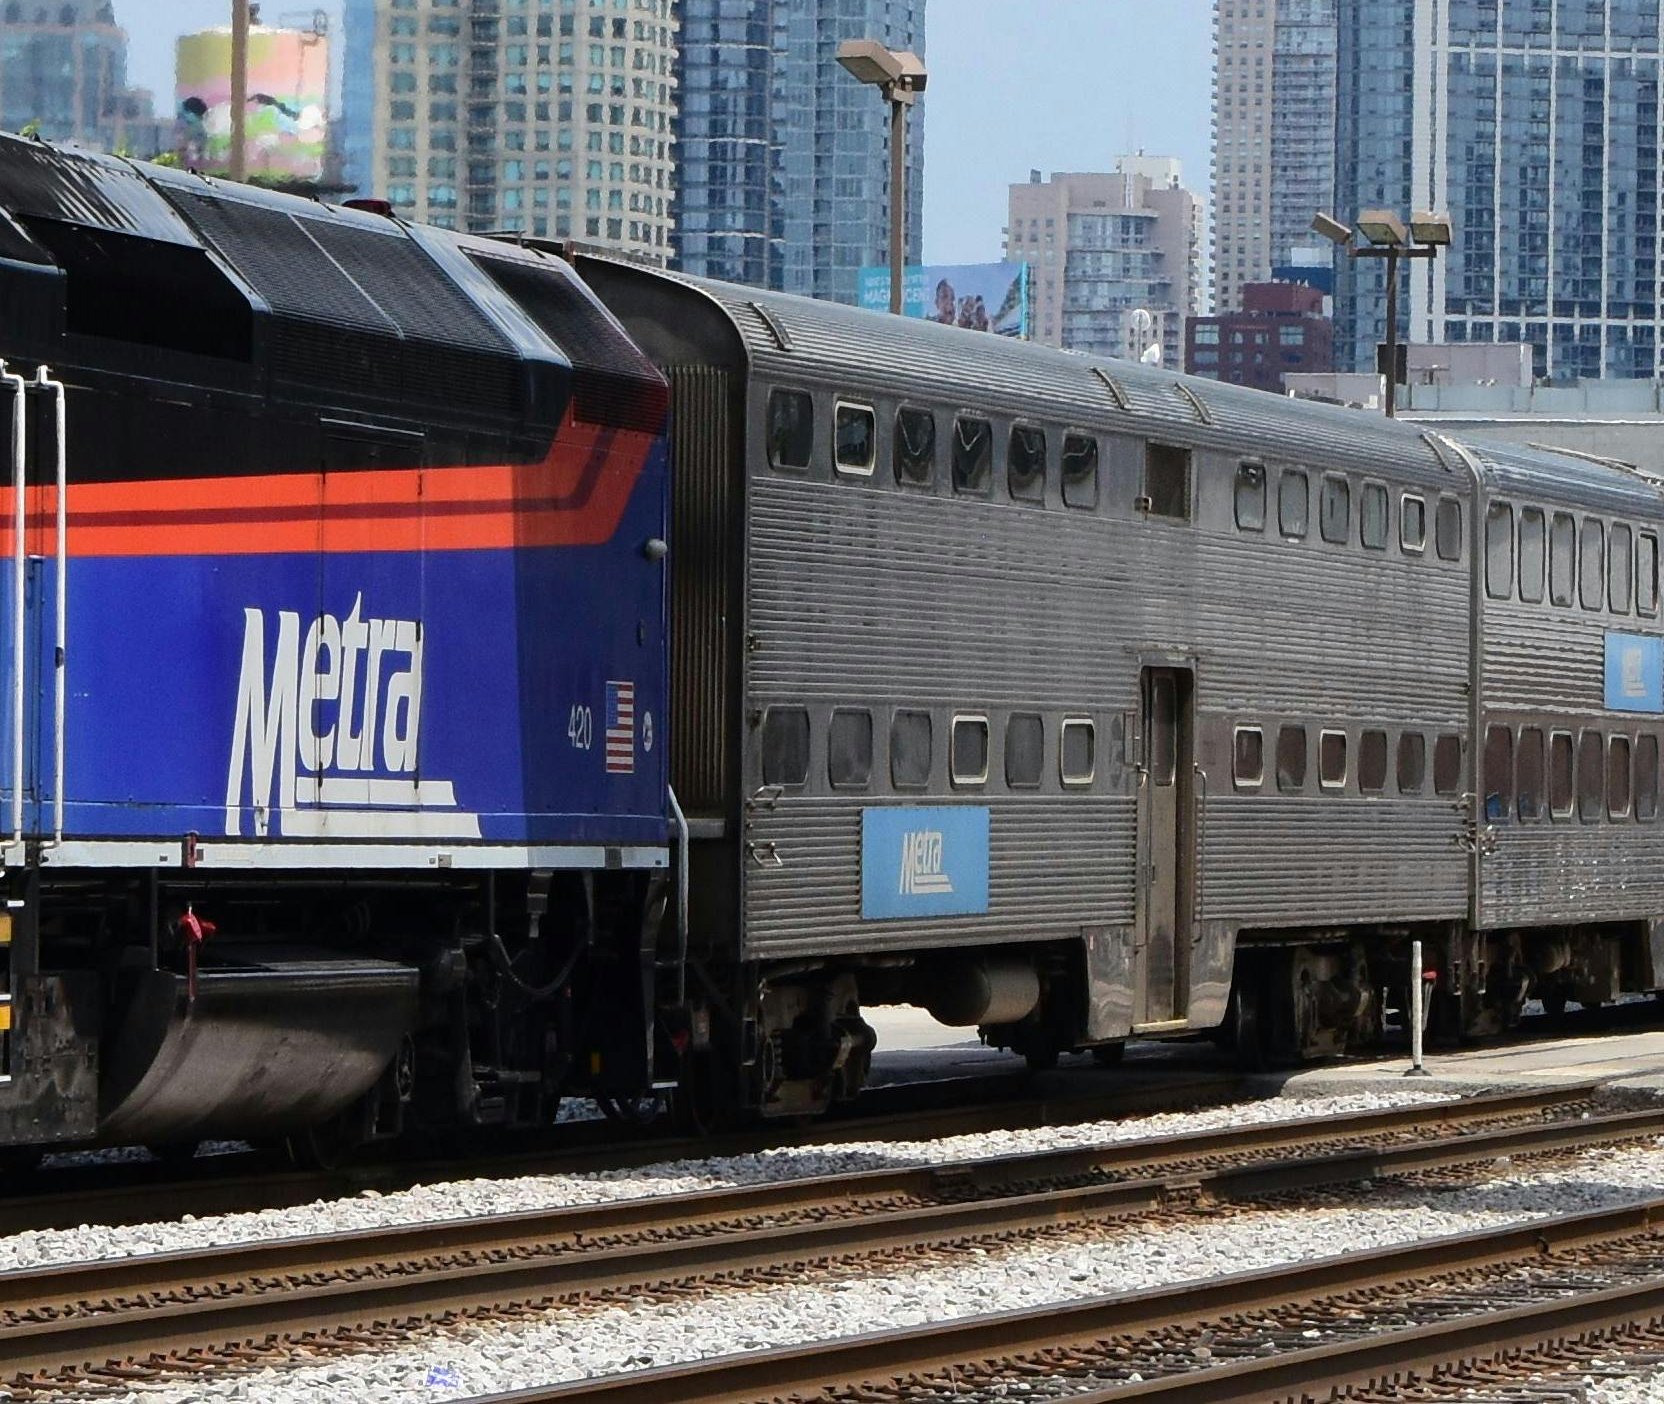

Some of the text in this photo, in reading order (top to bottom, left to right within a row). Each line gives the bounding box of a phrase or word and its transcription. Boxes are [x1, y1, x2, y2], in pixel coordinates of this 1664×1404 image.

[225, 590, 441, 837] Metra
[567, 704, 593, 750] 420
[899, 828, 944, 894] Metra
